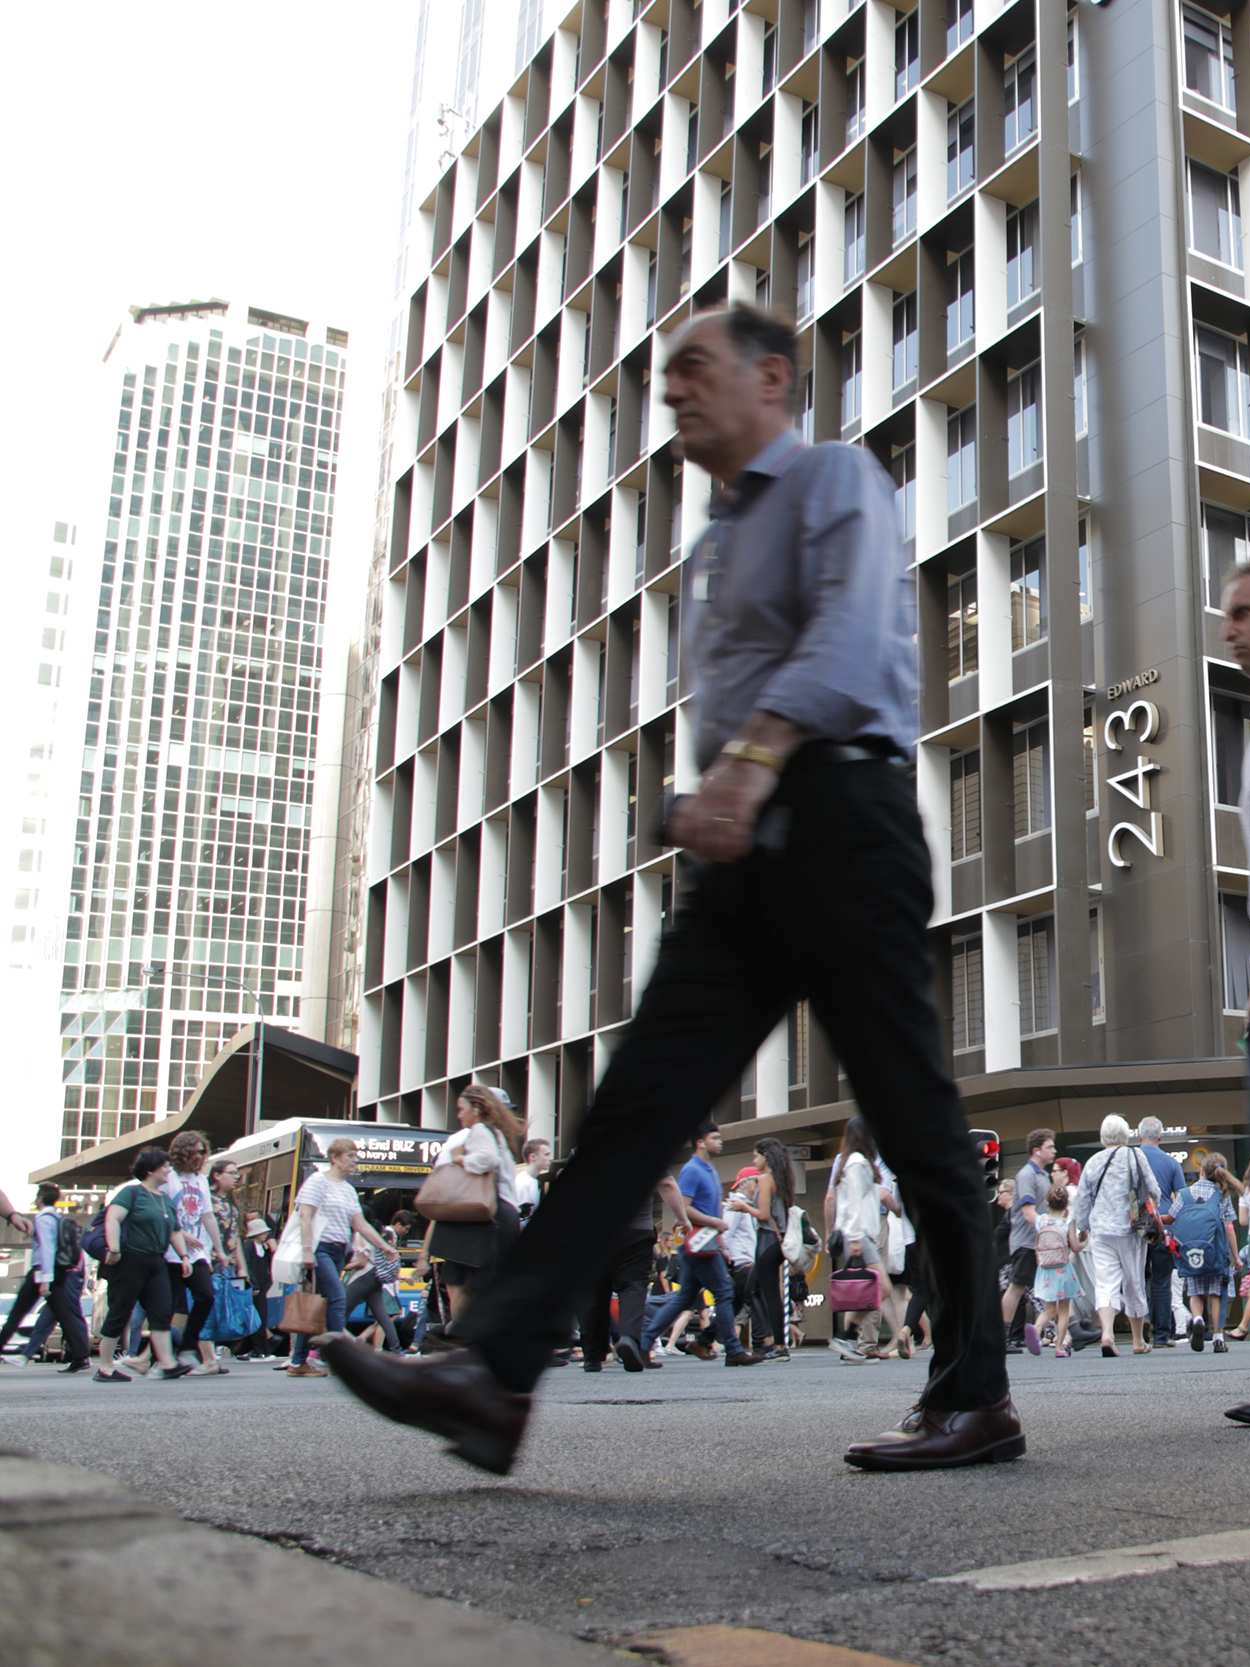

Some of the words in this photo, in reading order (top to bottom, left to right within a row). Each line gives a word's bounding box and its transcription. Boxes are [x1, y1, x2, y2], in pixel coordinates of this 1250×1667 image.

[1107, 669, 1159, 699] EDWARD
[1104, 700, 1165, 868] 243
[366, 1151, 387, 1160] Ivory
[368, 1139, 390, 1151] End
[392, 1140, 415, 1152] BUZ
